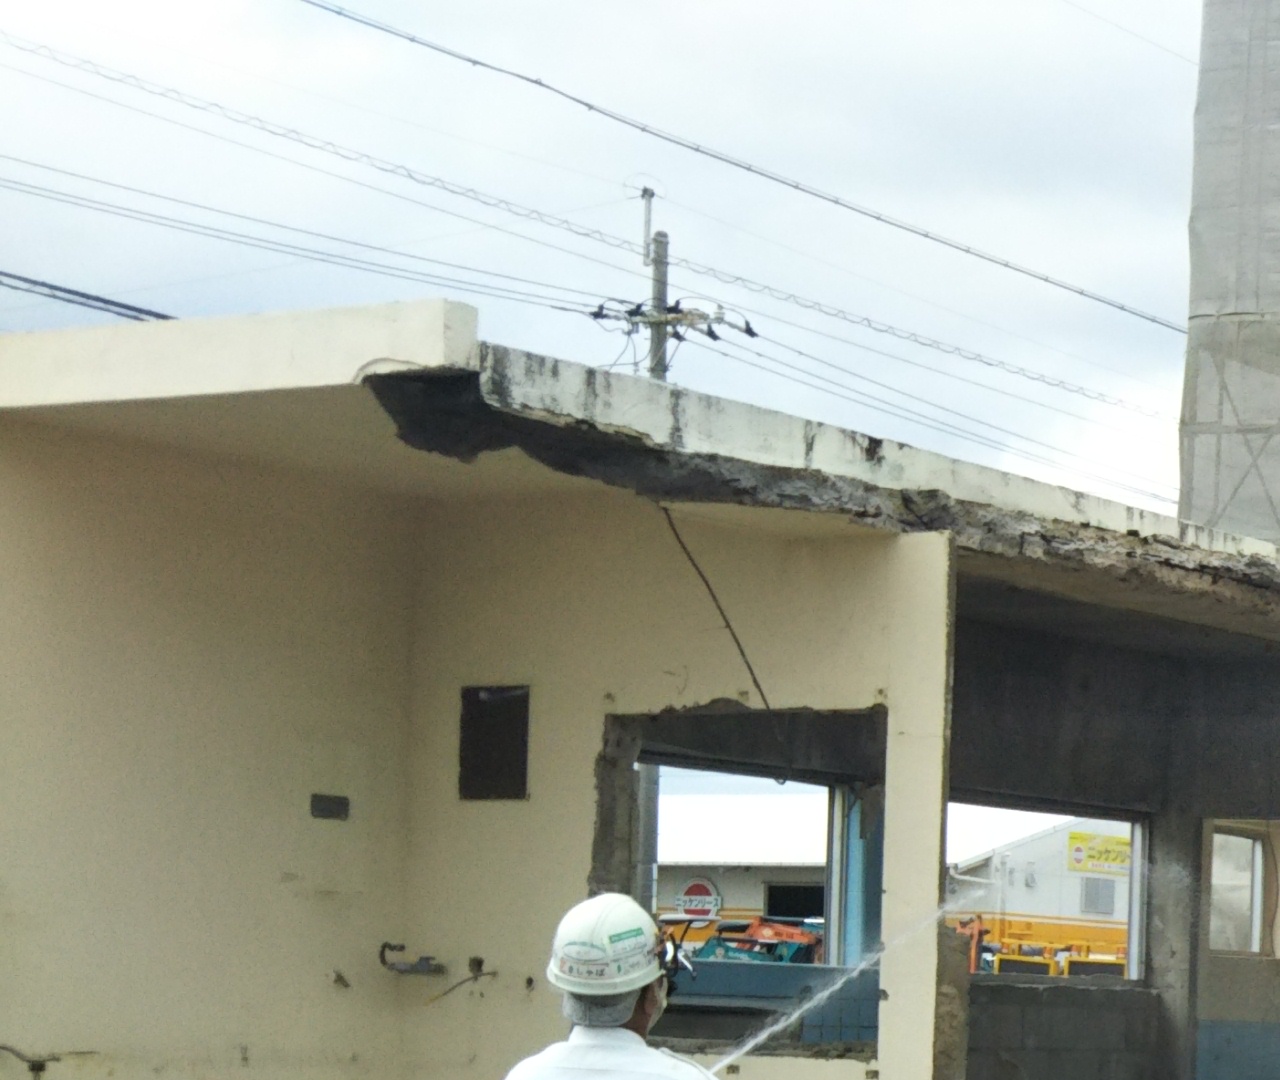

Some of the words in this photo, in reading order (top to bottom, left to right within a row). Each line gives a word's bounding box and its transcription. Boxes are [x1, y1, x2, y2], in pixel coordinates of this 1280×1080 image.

[675, 897, 719, 908] ニッケンリース
